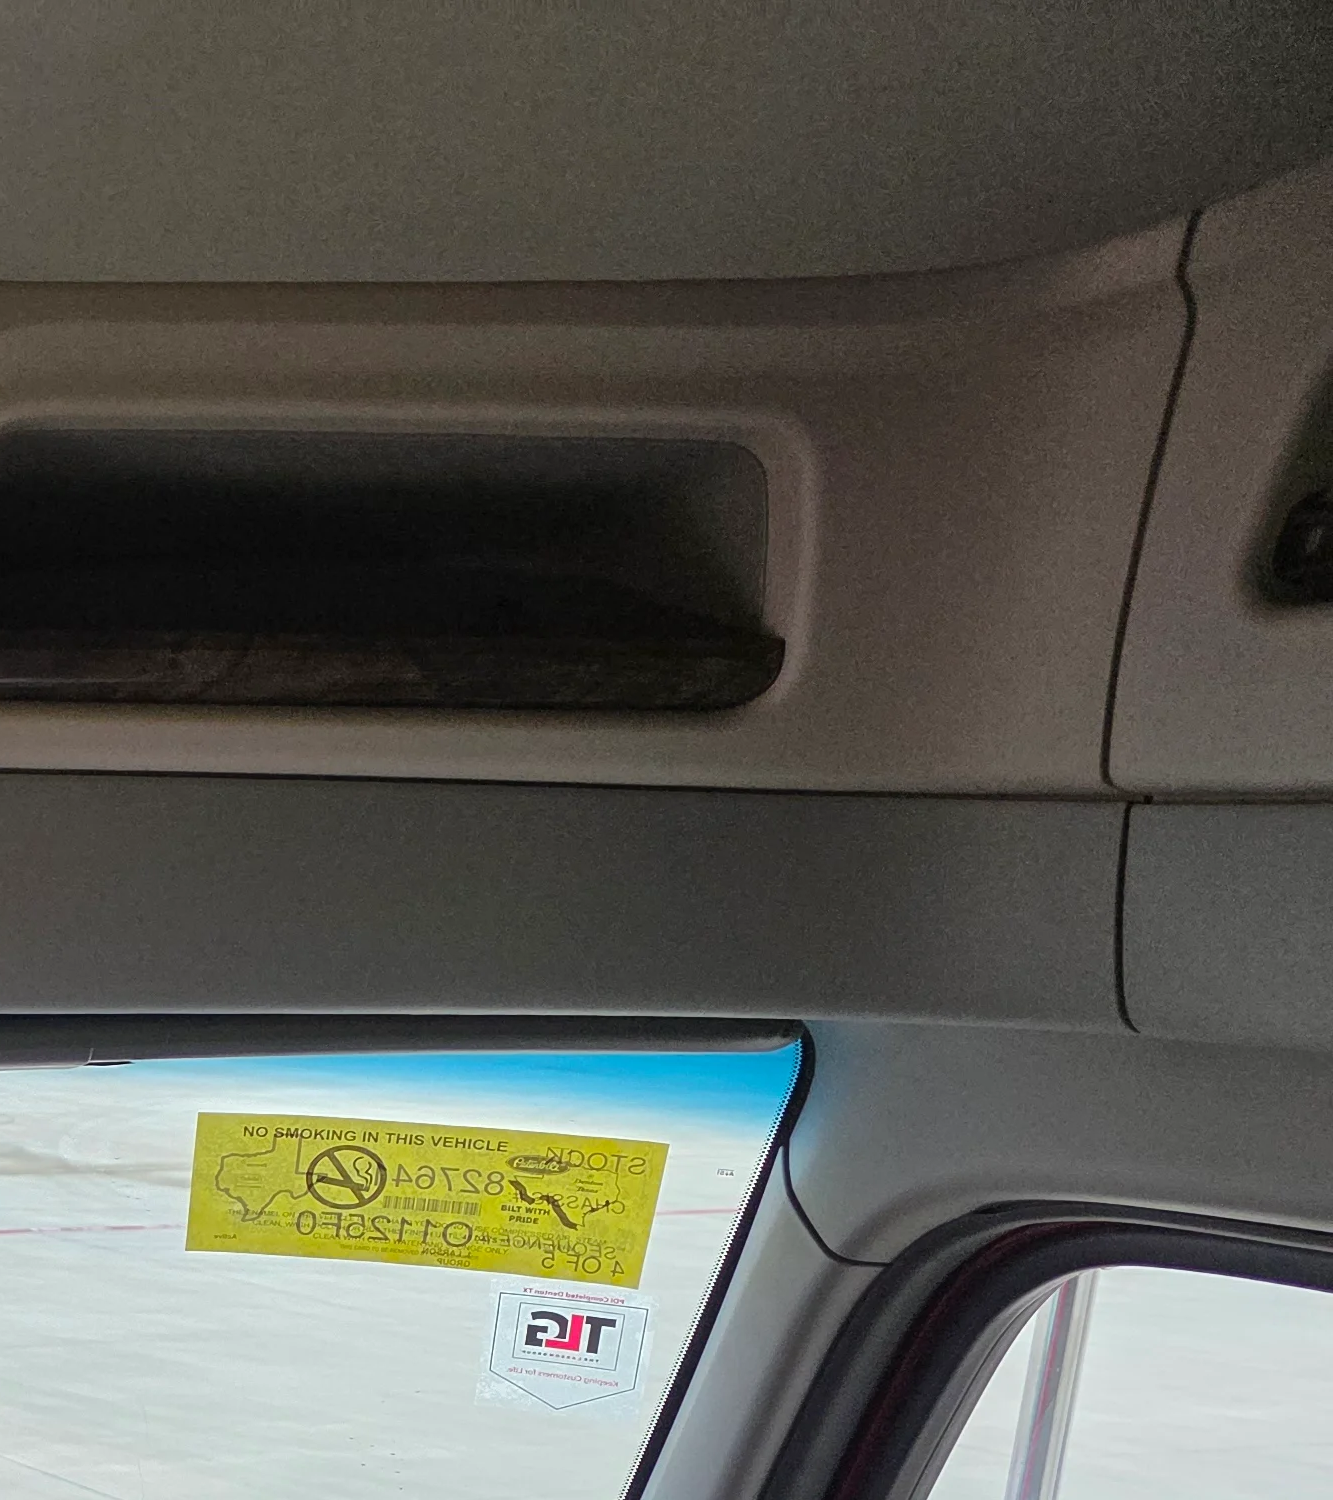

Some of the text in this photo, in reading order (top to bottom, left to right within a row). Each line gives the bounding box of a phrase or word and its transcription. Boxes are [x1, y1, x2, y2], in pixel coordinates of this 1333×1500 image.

[243, 1126, 509, 1152] NO SMOKING IN THIS VEHICLE
[501, 1204, 551, 1216] BILT WITH
[509, 1214, 539, 1225] PRIDE
